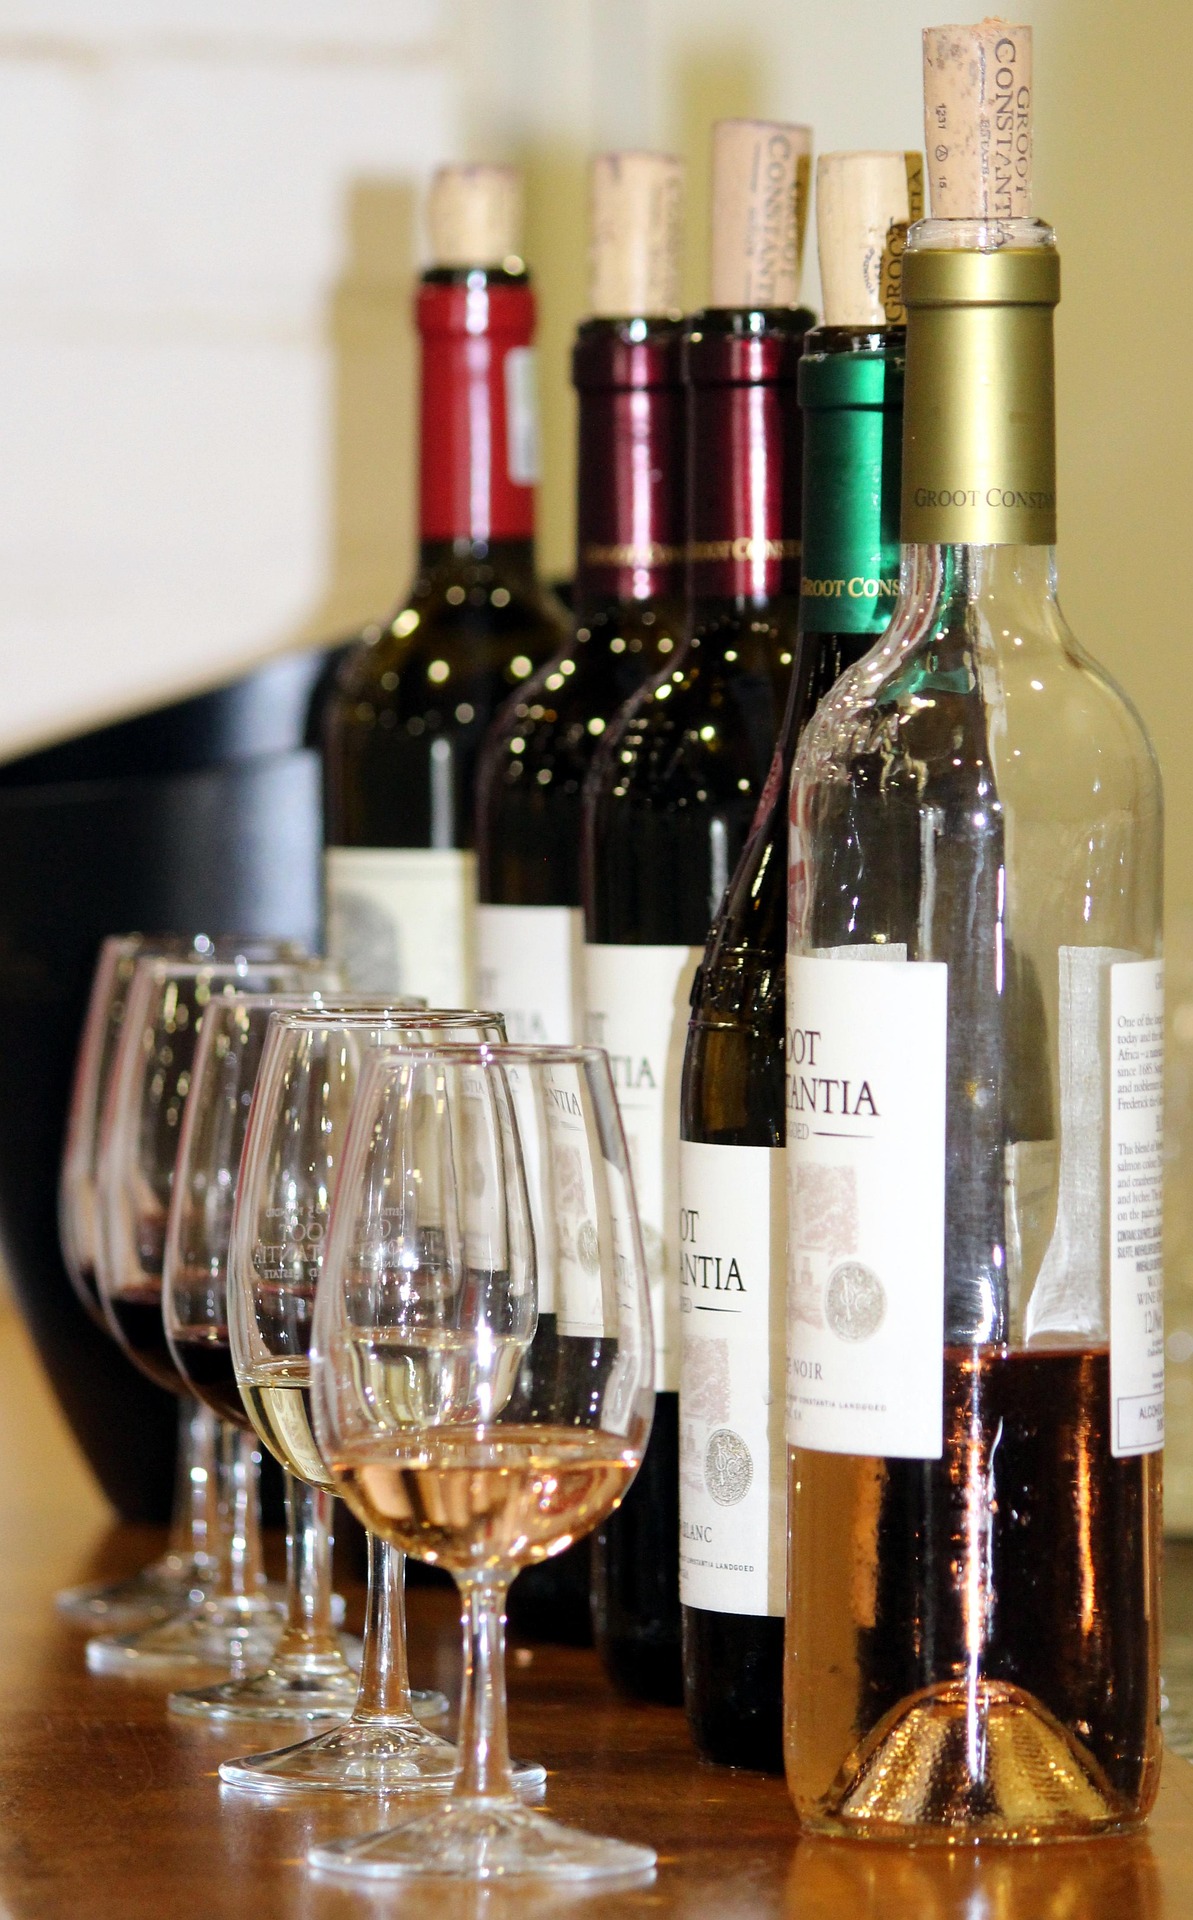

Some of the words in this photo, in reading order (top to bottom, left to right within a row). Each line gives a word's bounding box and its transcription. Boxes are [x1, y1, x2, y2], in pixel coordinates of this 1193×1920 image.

[1015, 85, 1031, 199] GROOT
[914, 487, 980, 508] GROOT
[1117, 1015, 1136, 1028] One
[1117, 1081, 1133, 1093] and
[1117, 1176, 1131, 1188] and
[1117, 1192, 1131, 1205] and
[793, 1358, 823, 1380] NOIR
[839, 1401, 887, 1412] LANDGOED
[715, 1562, 755, 1573] LANDGOED
